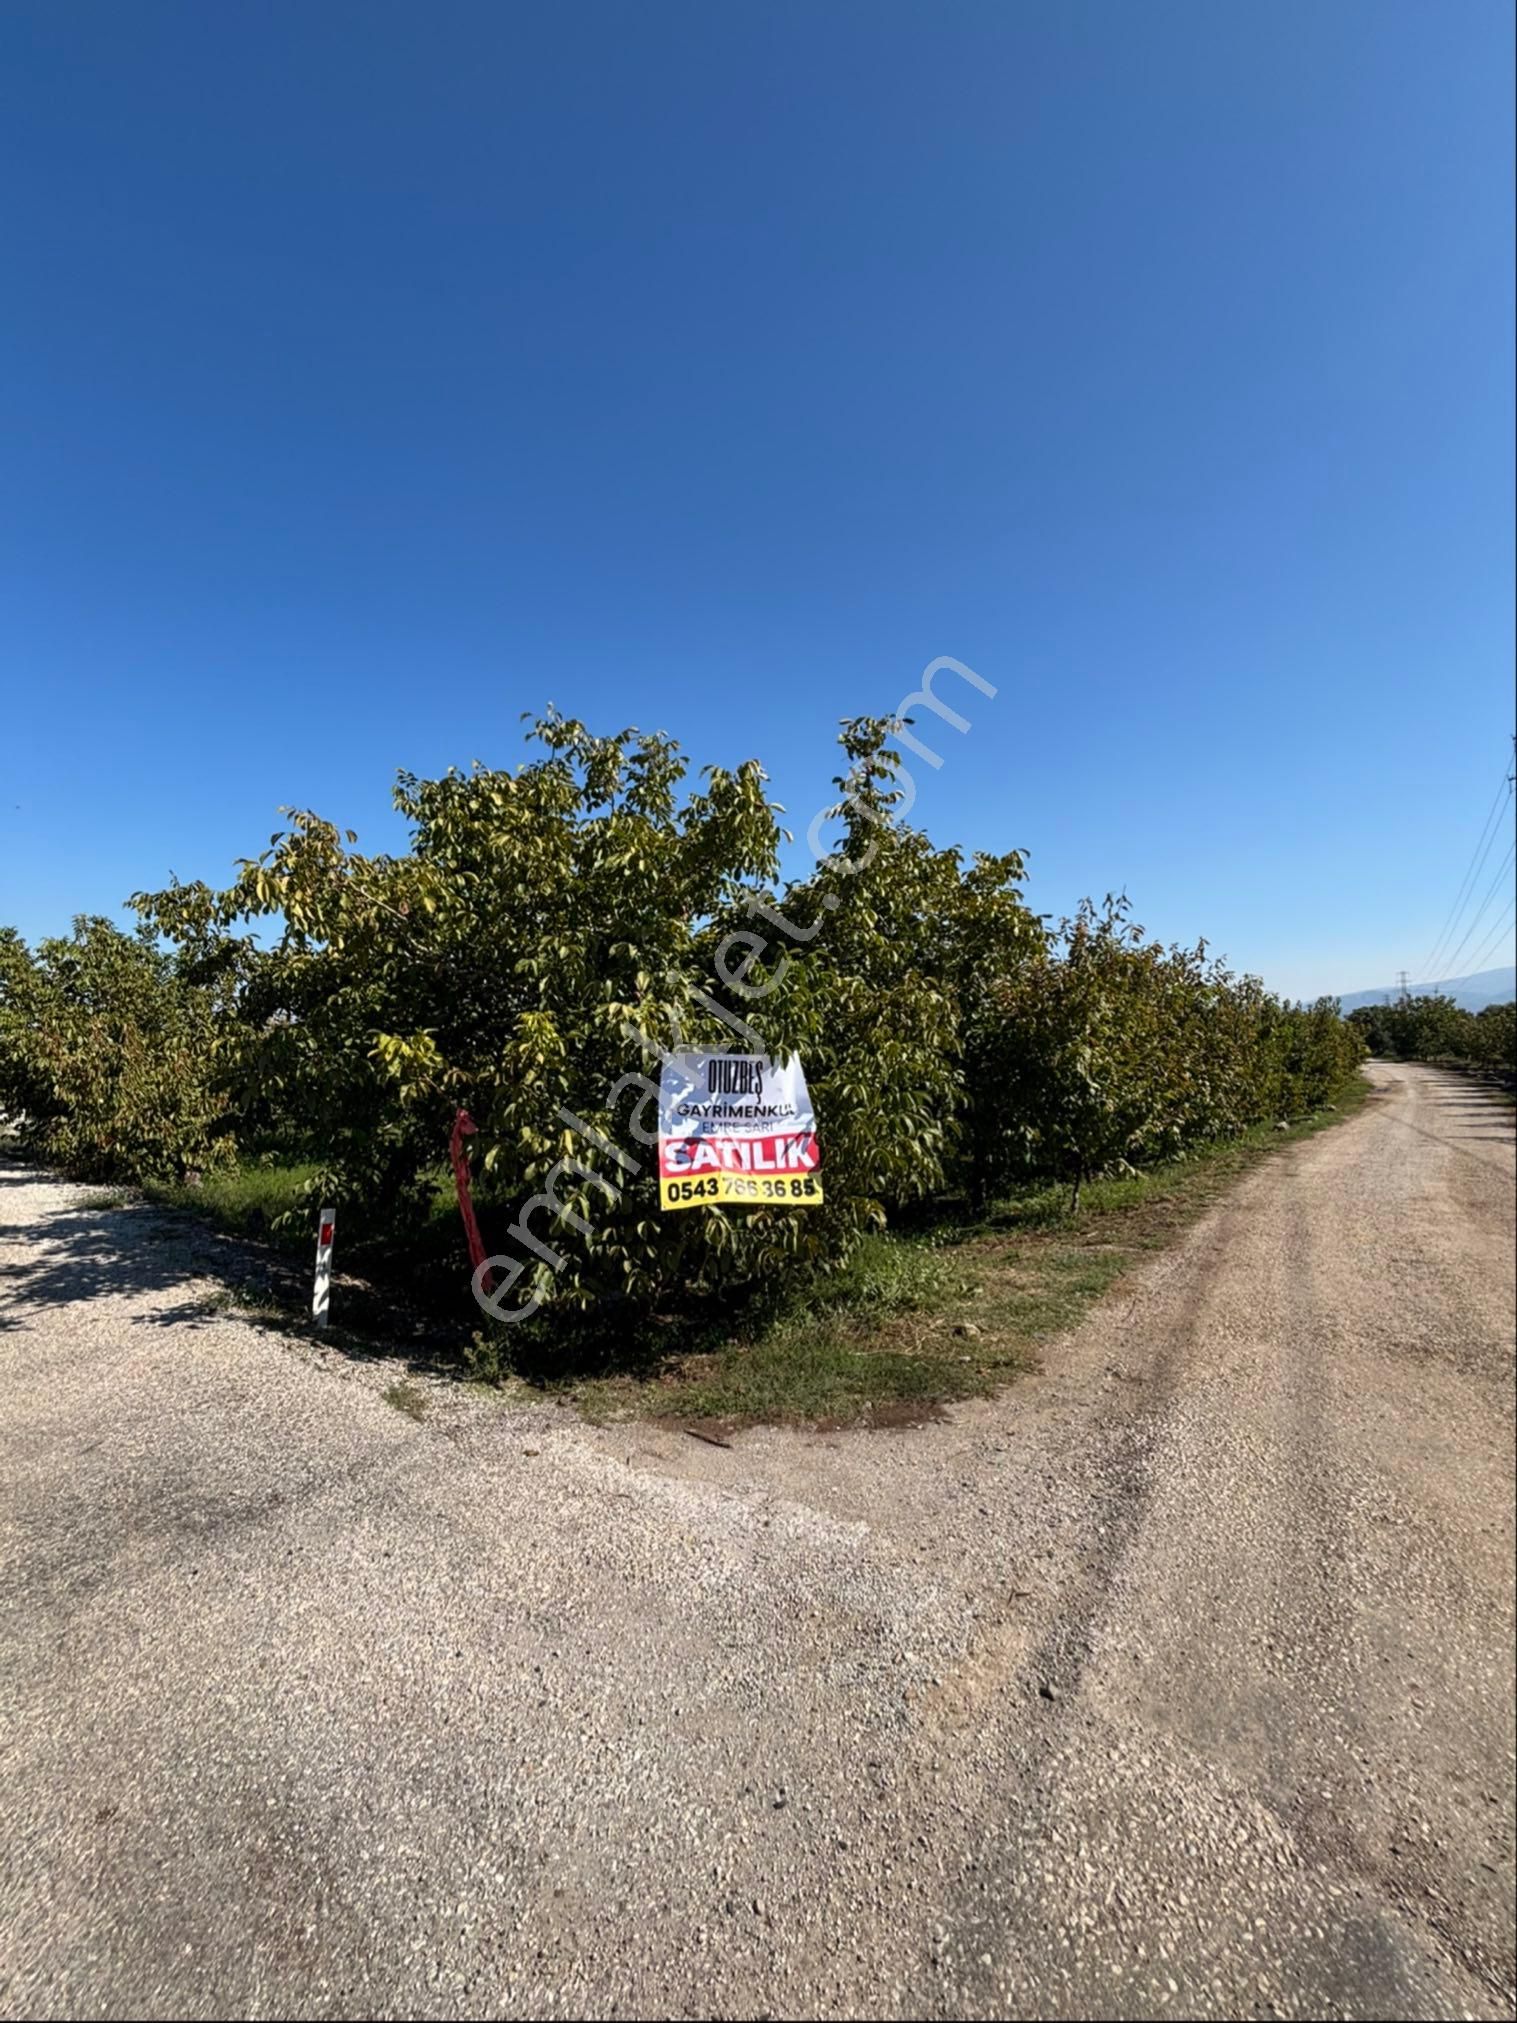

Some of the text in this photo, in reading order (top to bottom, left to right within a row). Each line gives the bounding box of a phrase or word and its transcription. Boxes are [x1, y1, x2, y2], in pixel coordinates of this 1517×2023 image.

[708, 1059, 763, 1104] OTUZBEŞ
[702, 1120, 774, 1133] EMRE SARI
[664, 1137, 816, 1172] SATILIK
[668, 1178, 719, 1202] 0543
[763, 1180, 785, 1198] 36
[790, 1178, 816, 1197] 85
